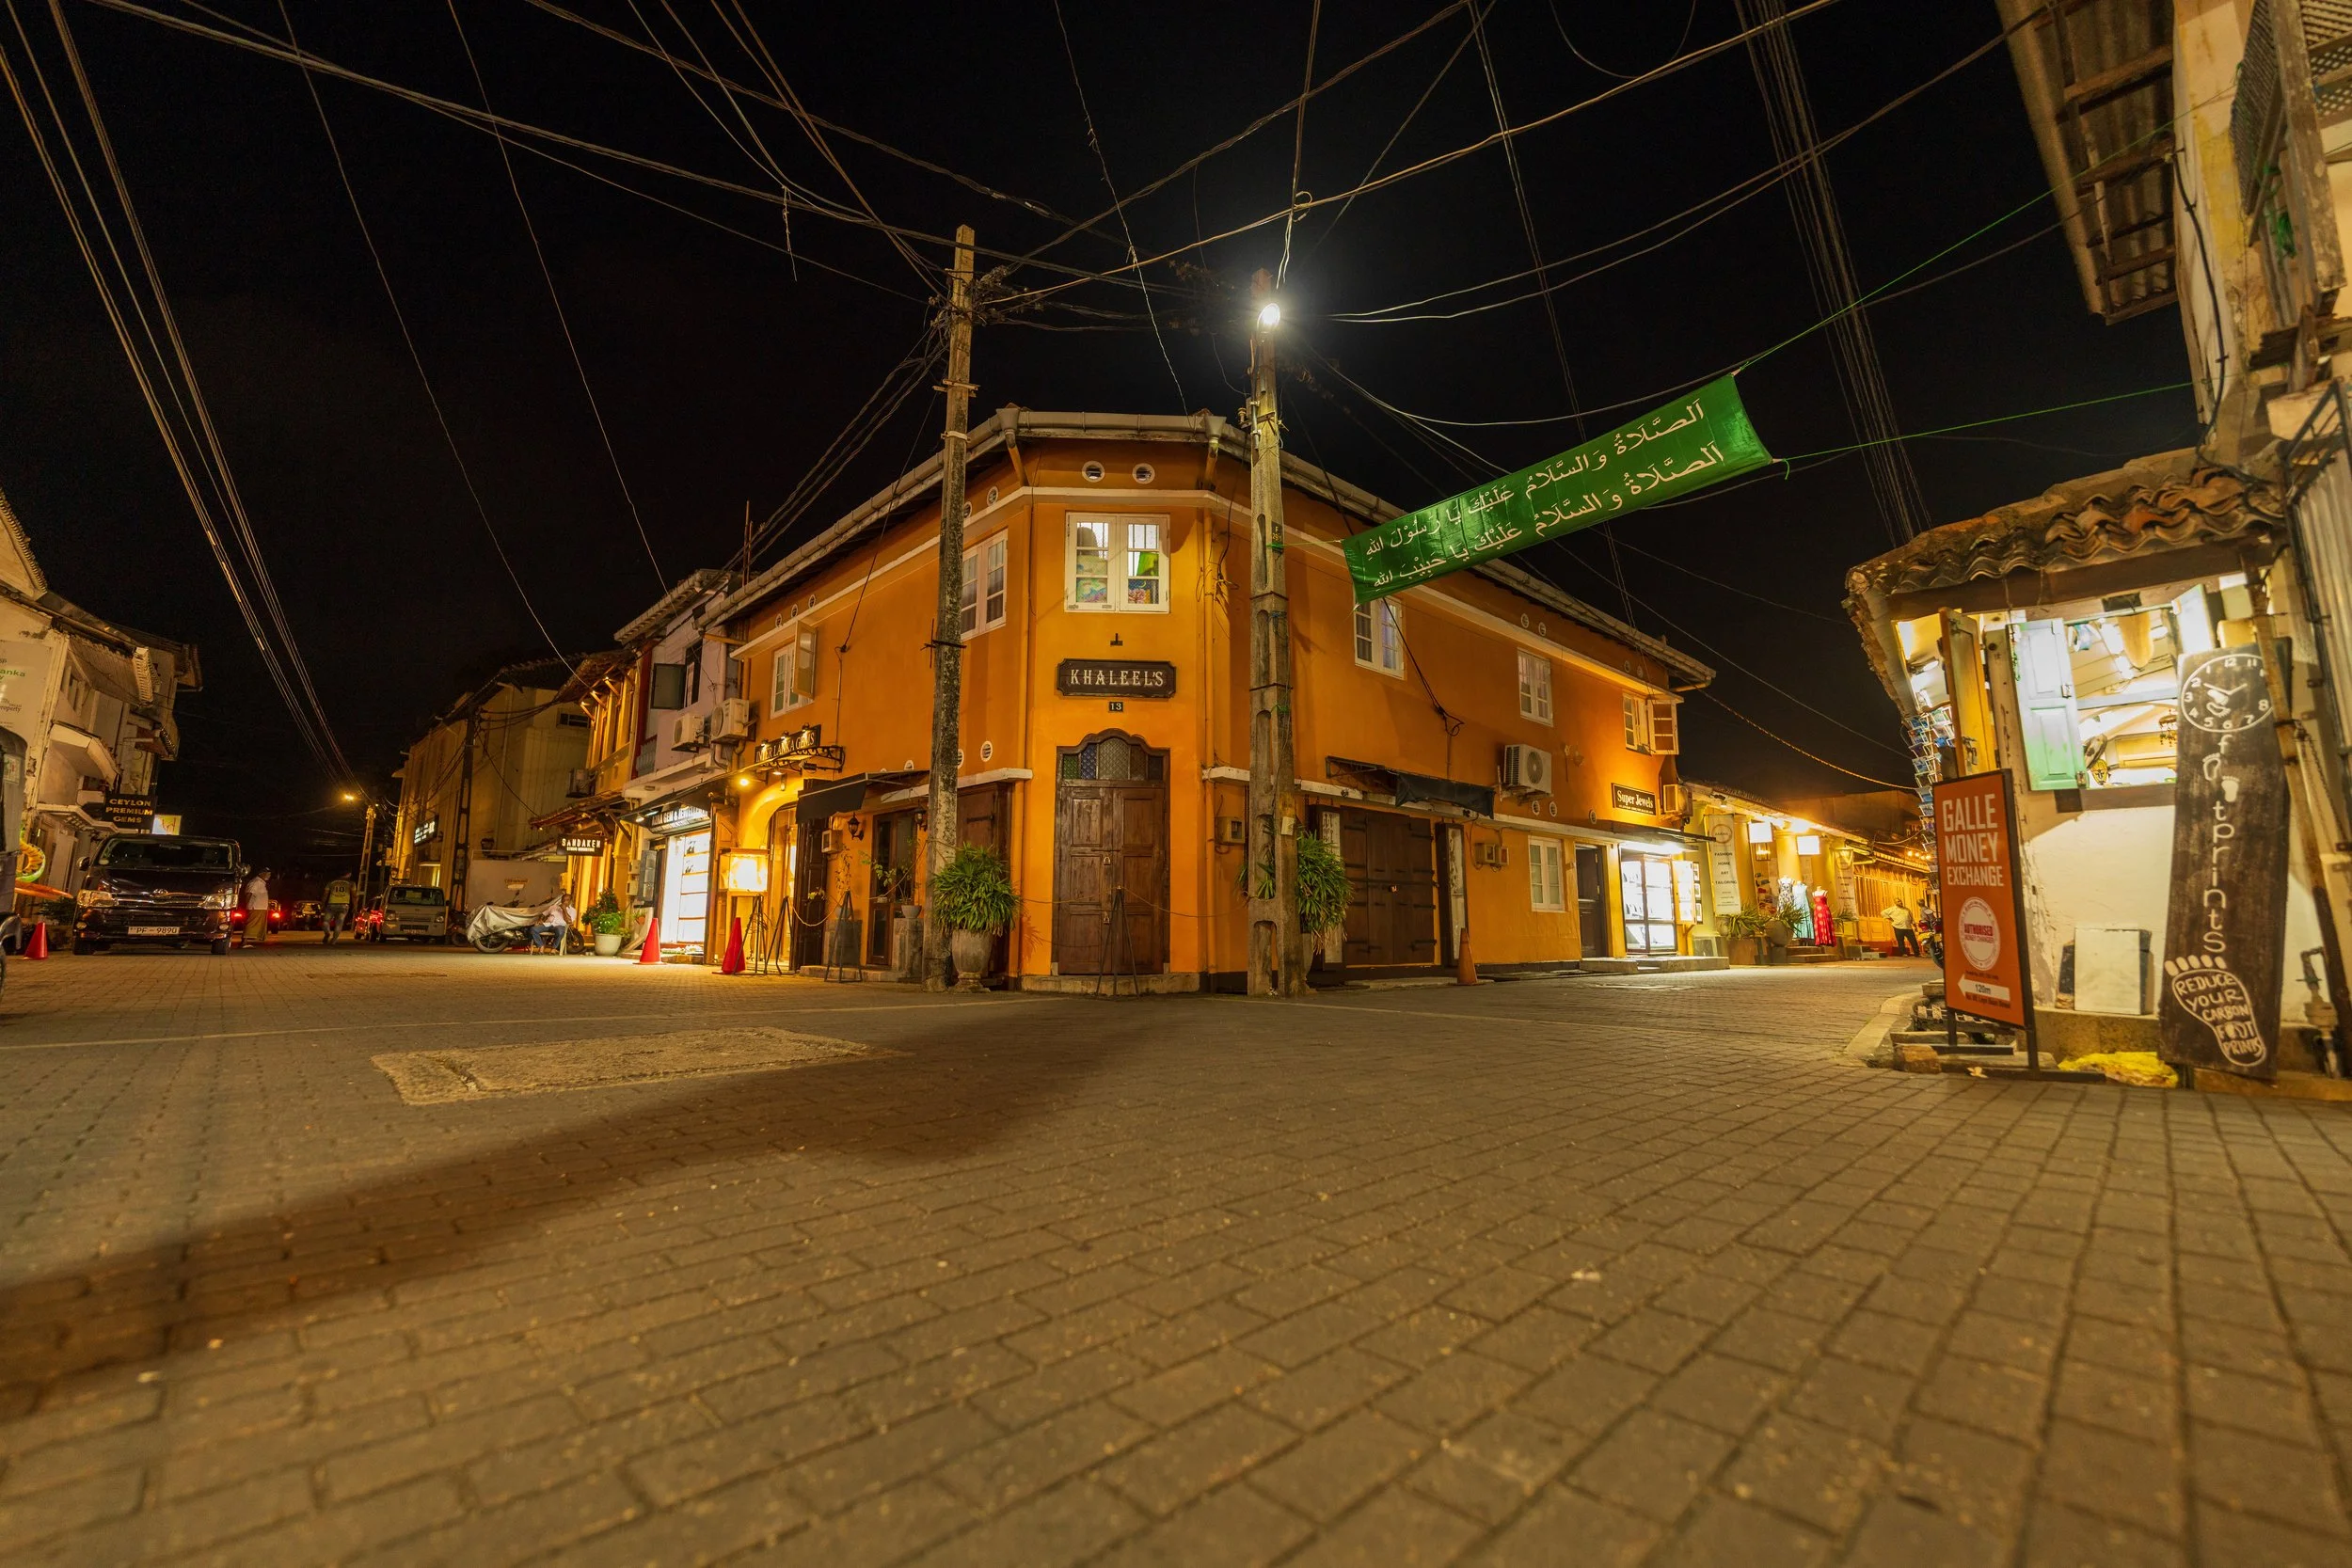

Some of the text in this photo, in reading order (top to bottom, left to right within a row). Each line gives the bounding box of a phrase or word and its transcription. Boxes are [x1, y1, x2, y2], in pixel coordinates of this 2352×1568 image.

[2224, 657, 2258, 668] 12 11
[1070, 669, 1165, 687] KHALEEL'S
[2190, 677, 2201, 689] 2
[1110, 703, 1122, 711] 13
[2184, 691, 2269, 712] 3 8
[2188, 706, 2200, 719] 4
[2202, 715, 2255, 730] 5 6 7
[1616, 790, 1654, 809] Super Jewels
[105, 806, 153, 816] PREMIUM
[1942, 793, 1998, 832] GALLE
[561, 838, 601, 847] SANDAKEN
[1944, 832, 1999, 863] MONEY
[1947, 865, 2005, 887] EXCHANGE
[2185, 989, 2244, 1012] YOUR
[2201, 1005, 2250, 1022] CARBON
